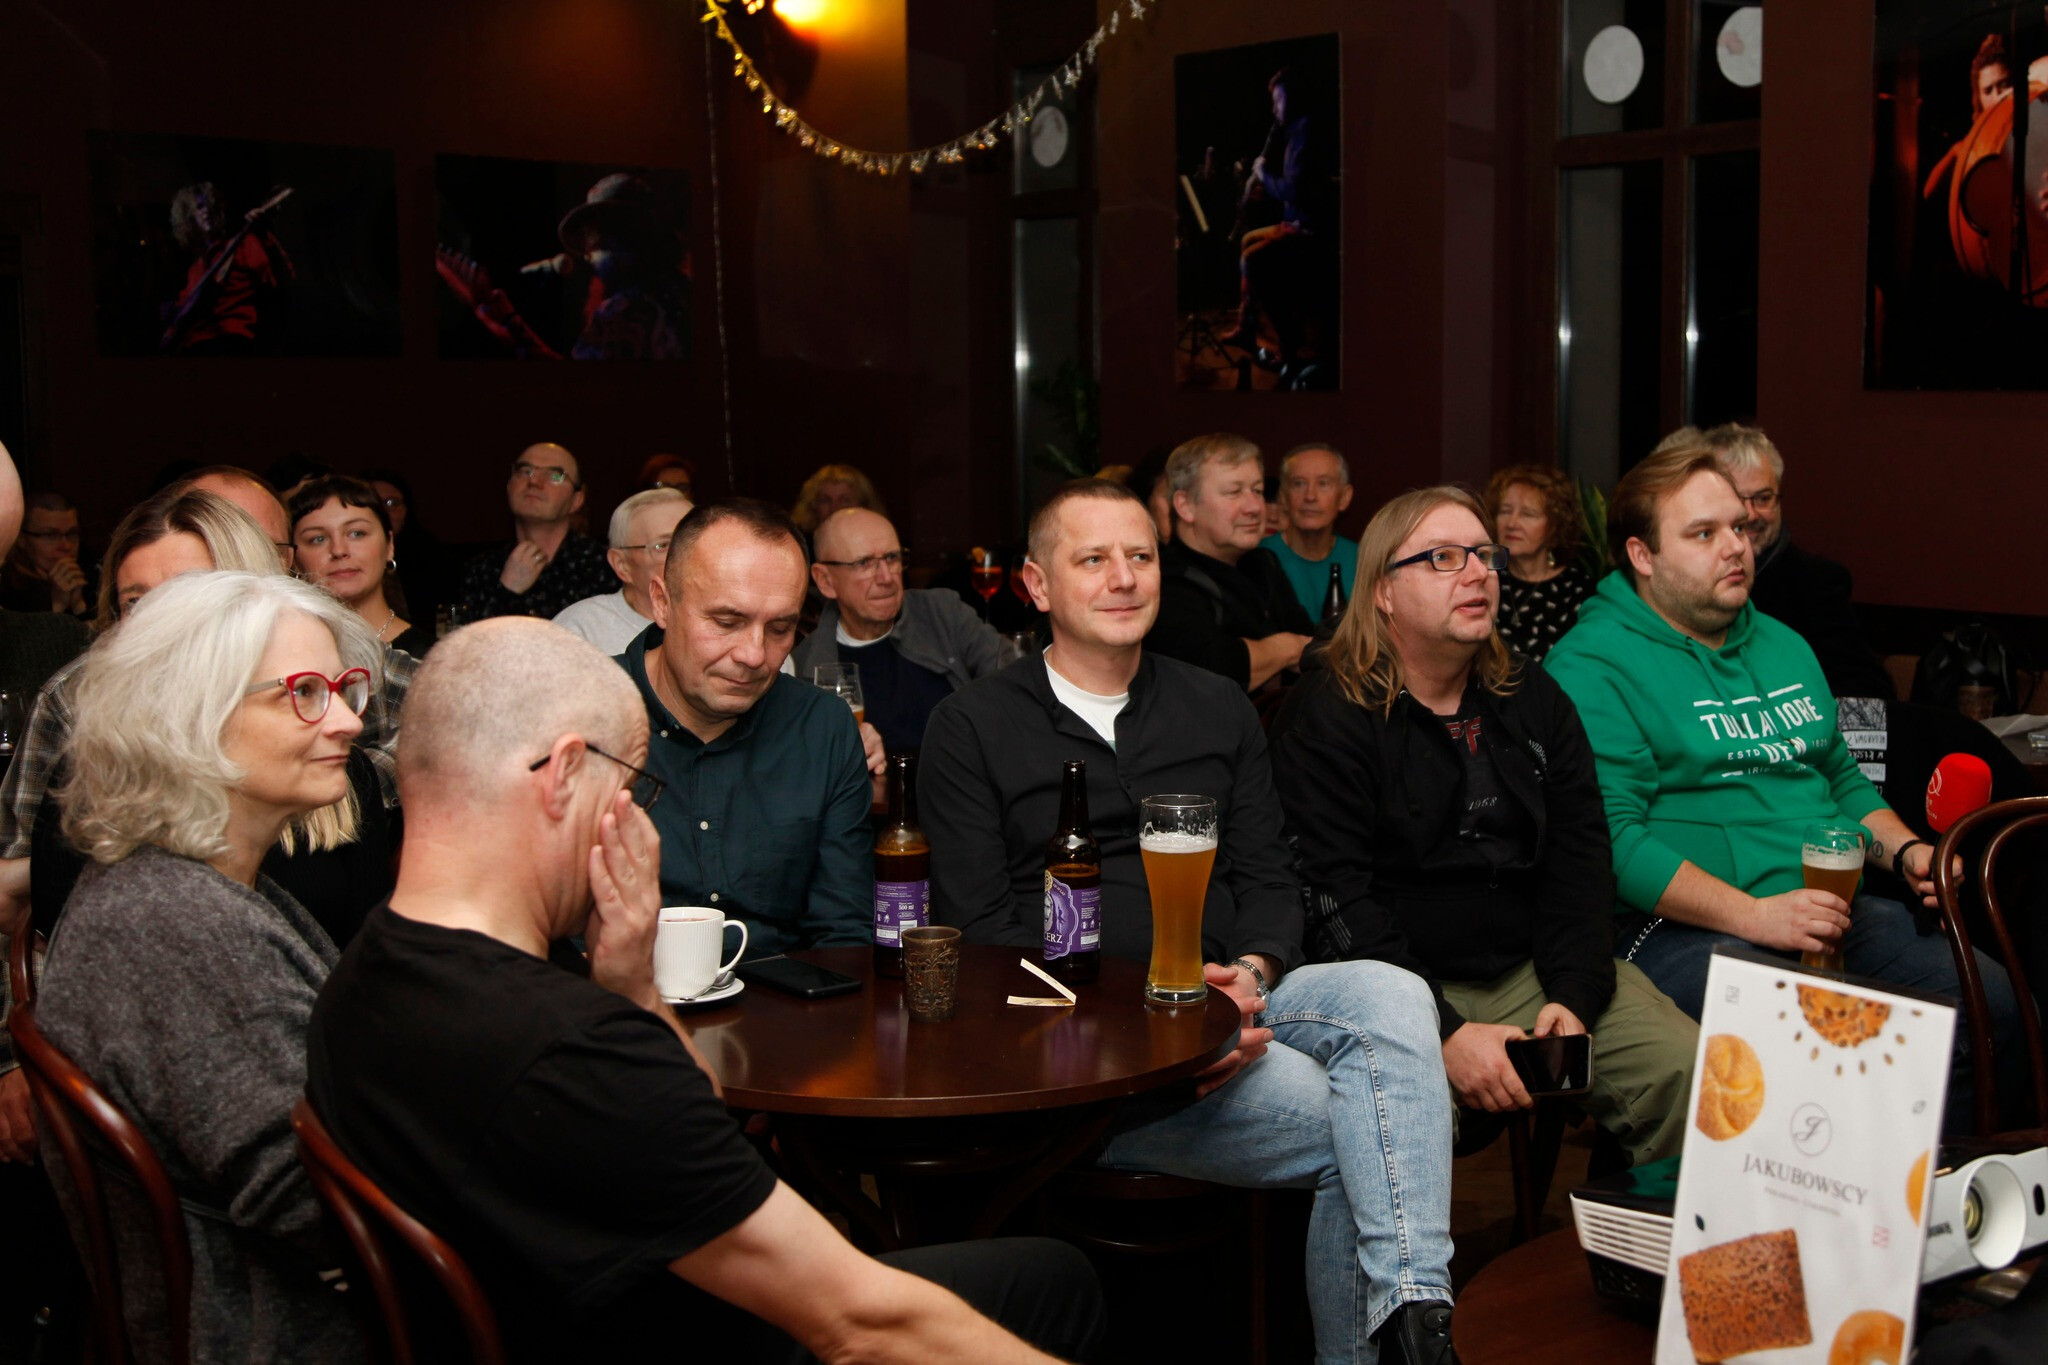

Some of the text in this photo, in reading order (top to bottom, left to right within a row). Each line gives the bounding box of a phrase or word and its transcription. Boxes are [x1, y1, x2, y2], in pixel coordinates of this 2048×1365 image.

[1727, 748, 1760, 760] ESTD
[1468, 797, 1498, 811] 1968
[1743, 1153, 1868, 1205] JAKUBOWSCY
